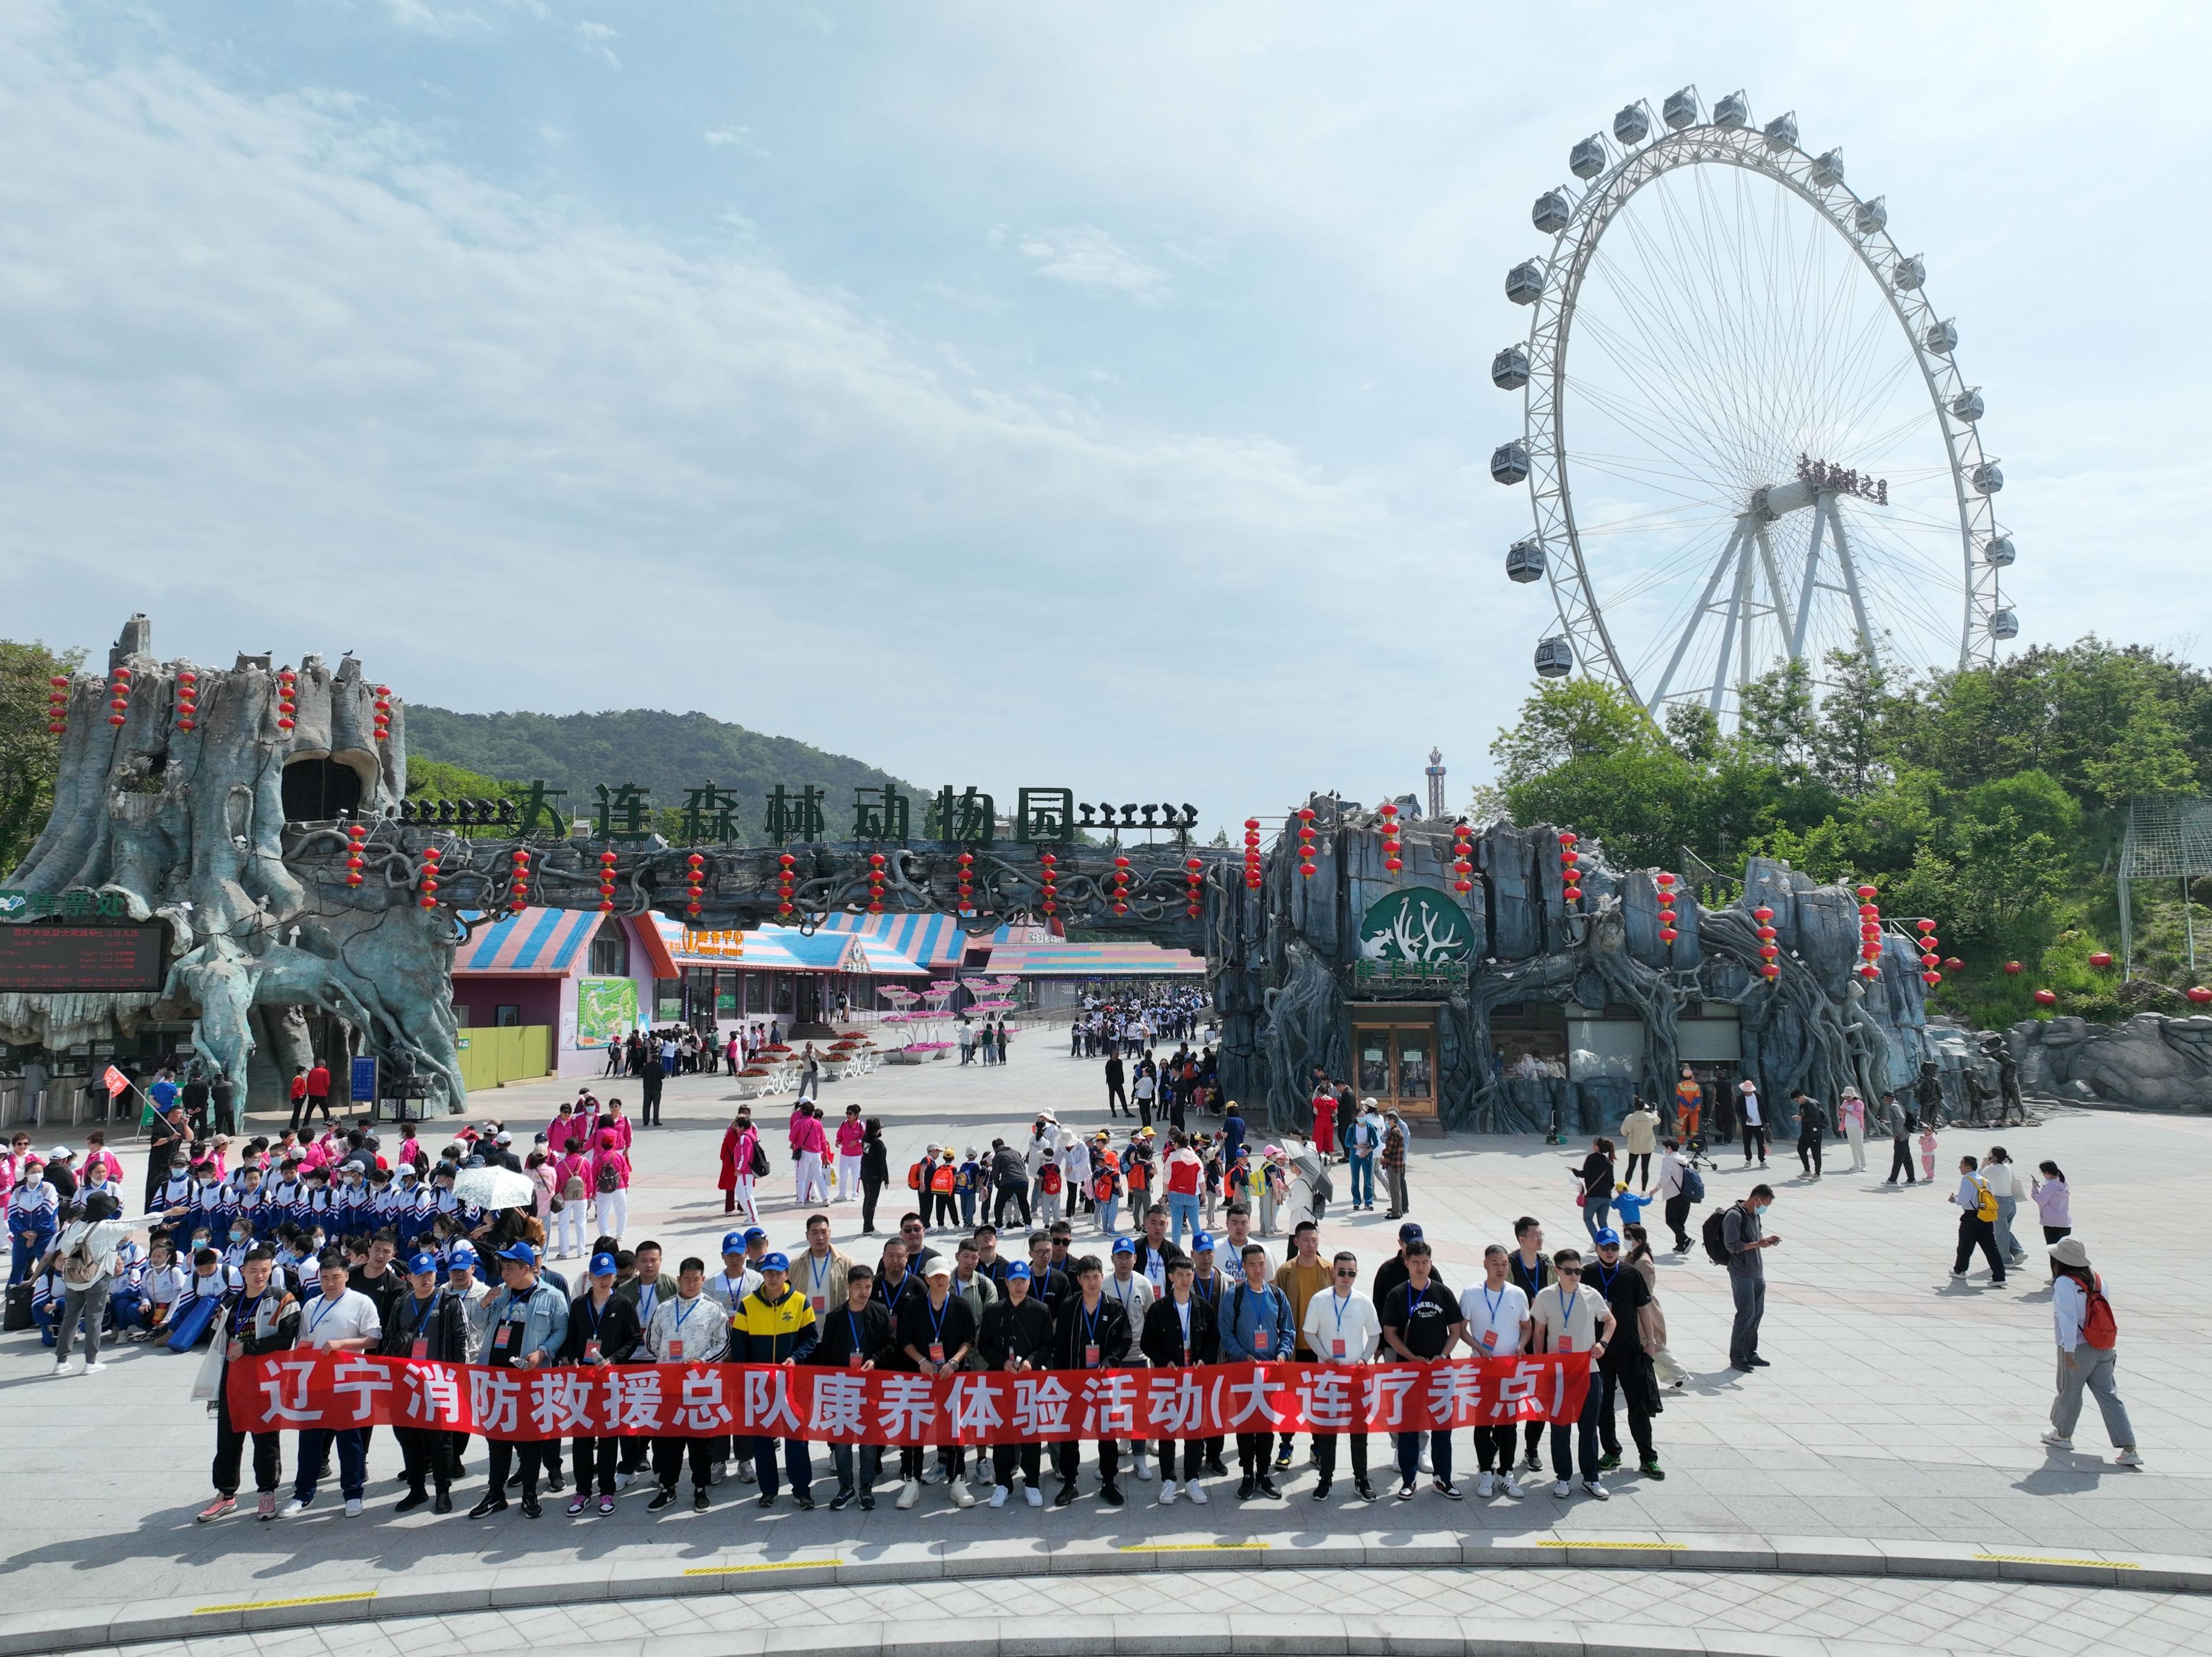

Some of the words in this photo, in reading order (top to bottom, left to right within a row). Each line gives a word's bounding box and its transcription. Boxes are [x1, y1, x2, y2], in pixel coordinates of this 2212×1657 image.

[509, 779, 1074, 844] 大连森林动物园
[31, 891, 125, 917] 售票处
[698, 946, 720, 955] TOURIST
[723, 948, 743, 956] CENTER
[1356, 957, 1465, 982] 年卡中心
[1356, 981, 1395, 990] Annual
[1400, 981, 1426, 991] card
[1429, 982, 1468, 991] center
[260, 1358, 1565, 1440] 辽宁消防救援总队康养体验活动(大连疗养点)
